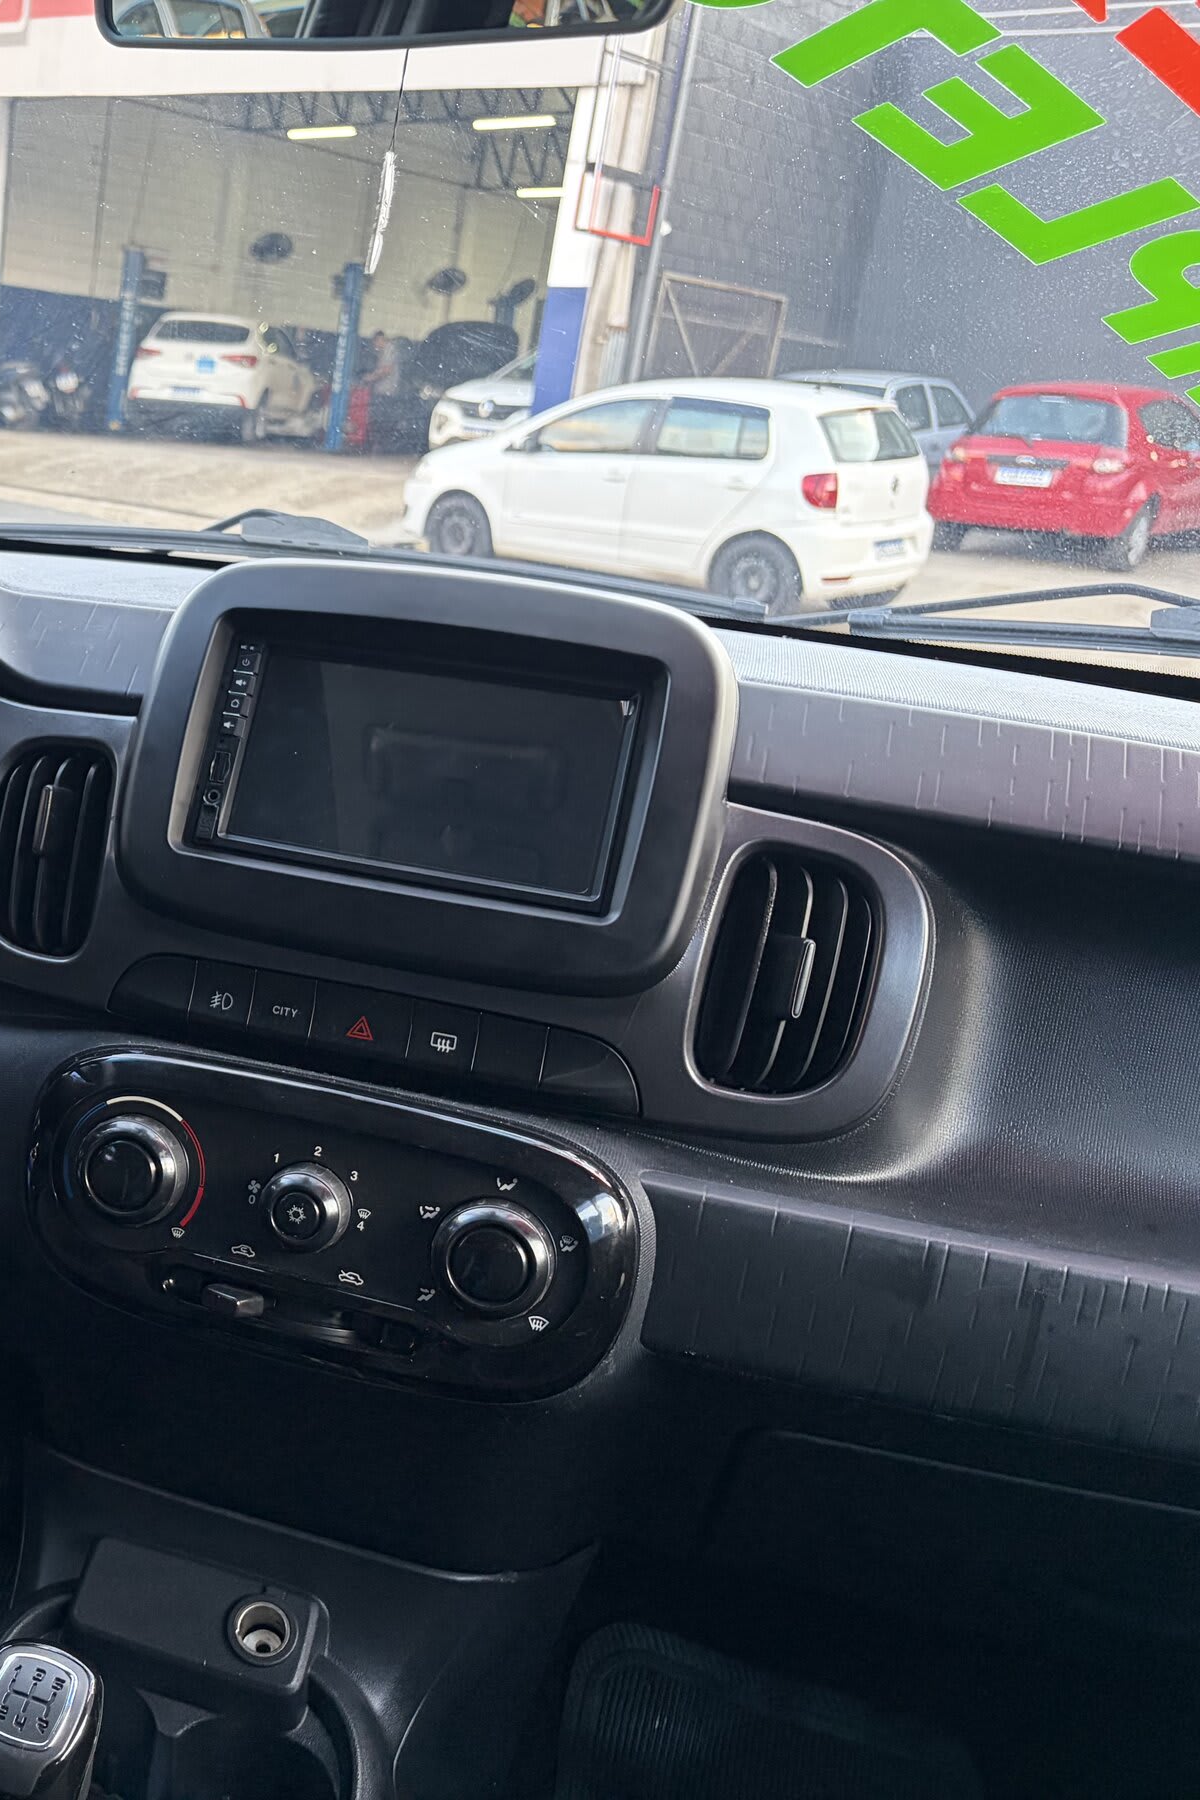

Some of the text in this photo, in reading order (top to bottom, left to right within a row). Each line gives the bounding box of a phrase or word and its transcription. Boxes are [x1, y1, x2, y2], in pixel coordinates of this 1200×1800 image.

[272, 1005, 298, 1018] CITY
[314, 1146, 322, 1156] 2
[273, 1153, 280, 1163] 1
[350, 1170, 358, 1181] 3
[248, 1194, 256, 1205] 0
[356, 1221, 365, 1231] 4
[32, 1667, 46, 1682] 3
[51, 1677, 66, 1691] 5
[13, 1714, 27, 1731] 4
[36, 1717, 49, 1734] R
